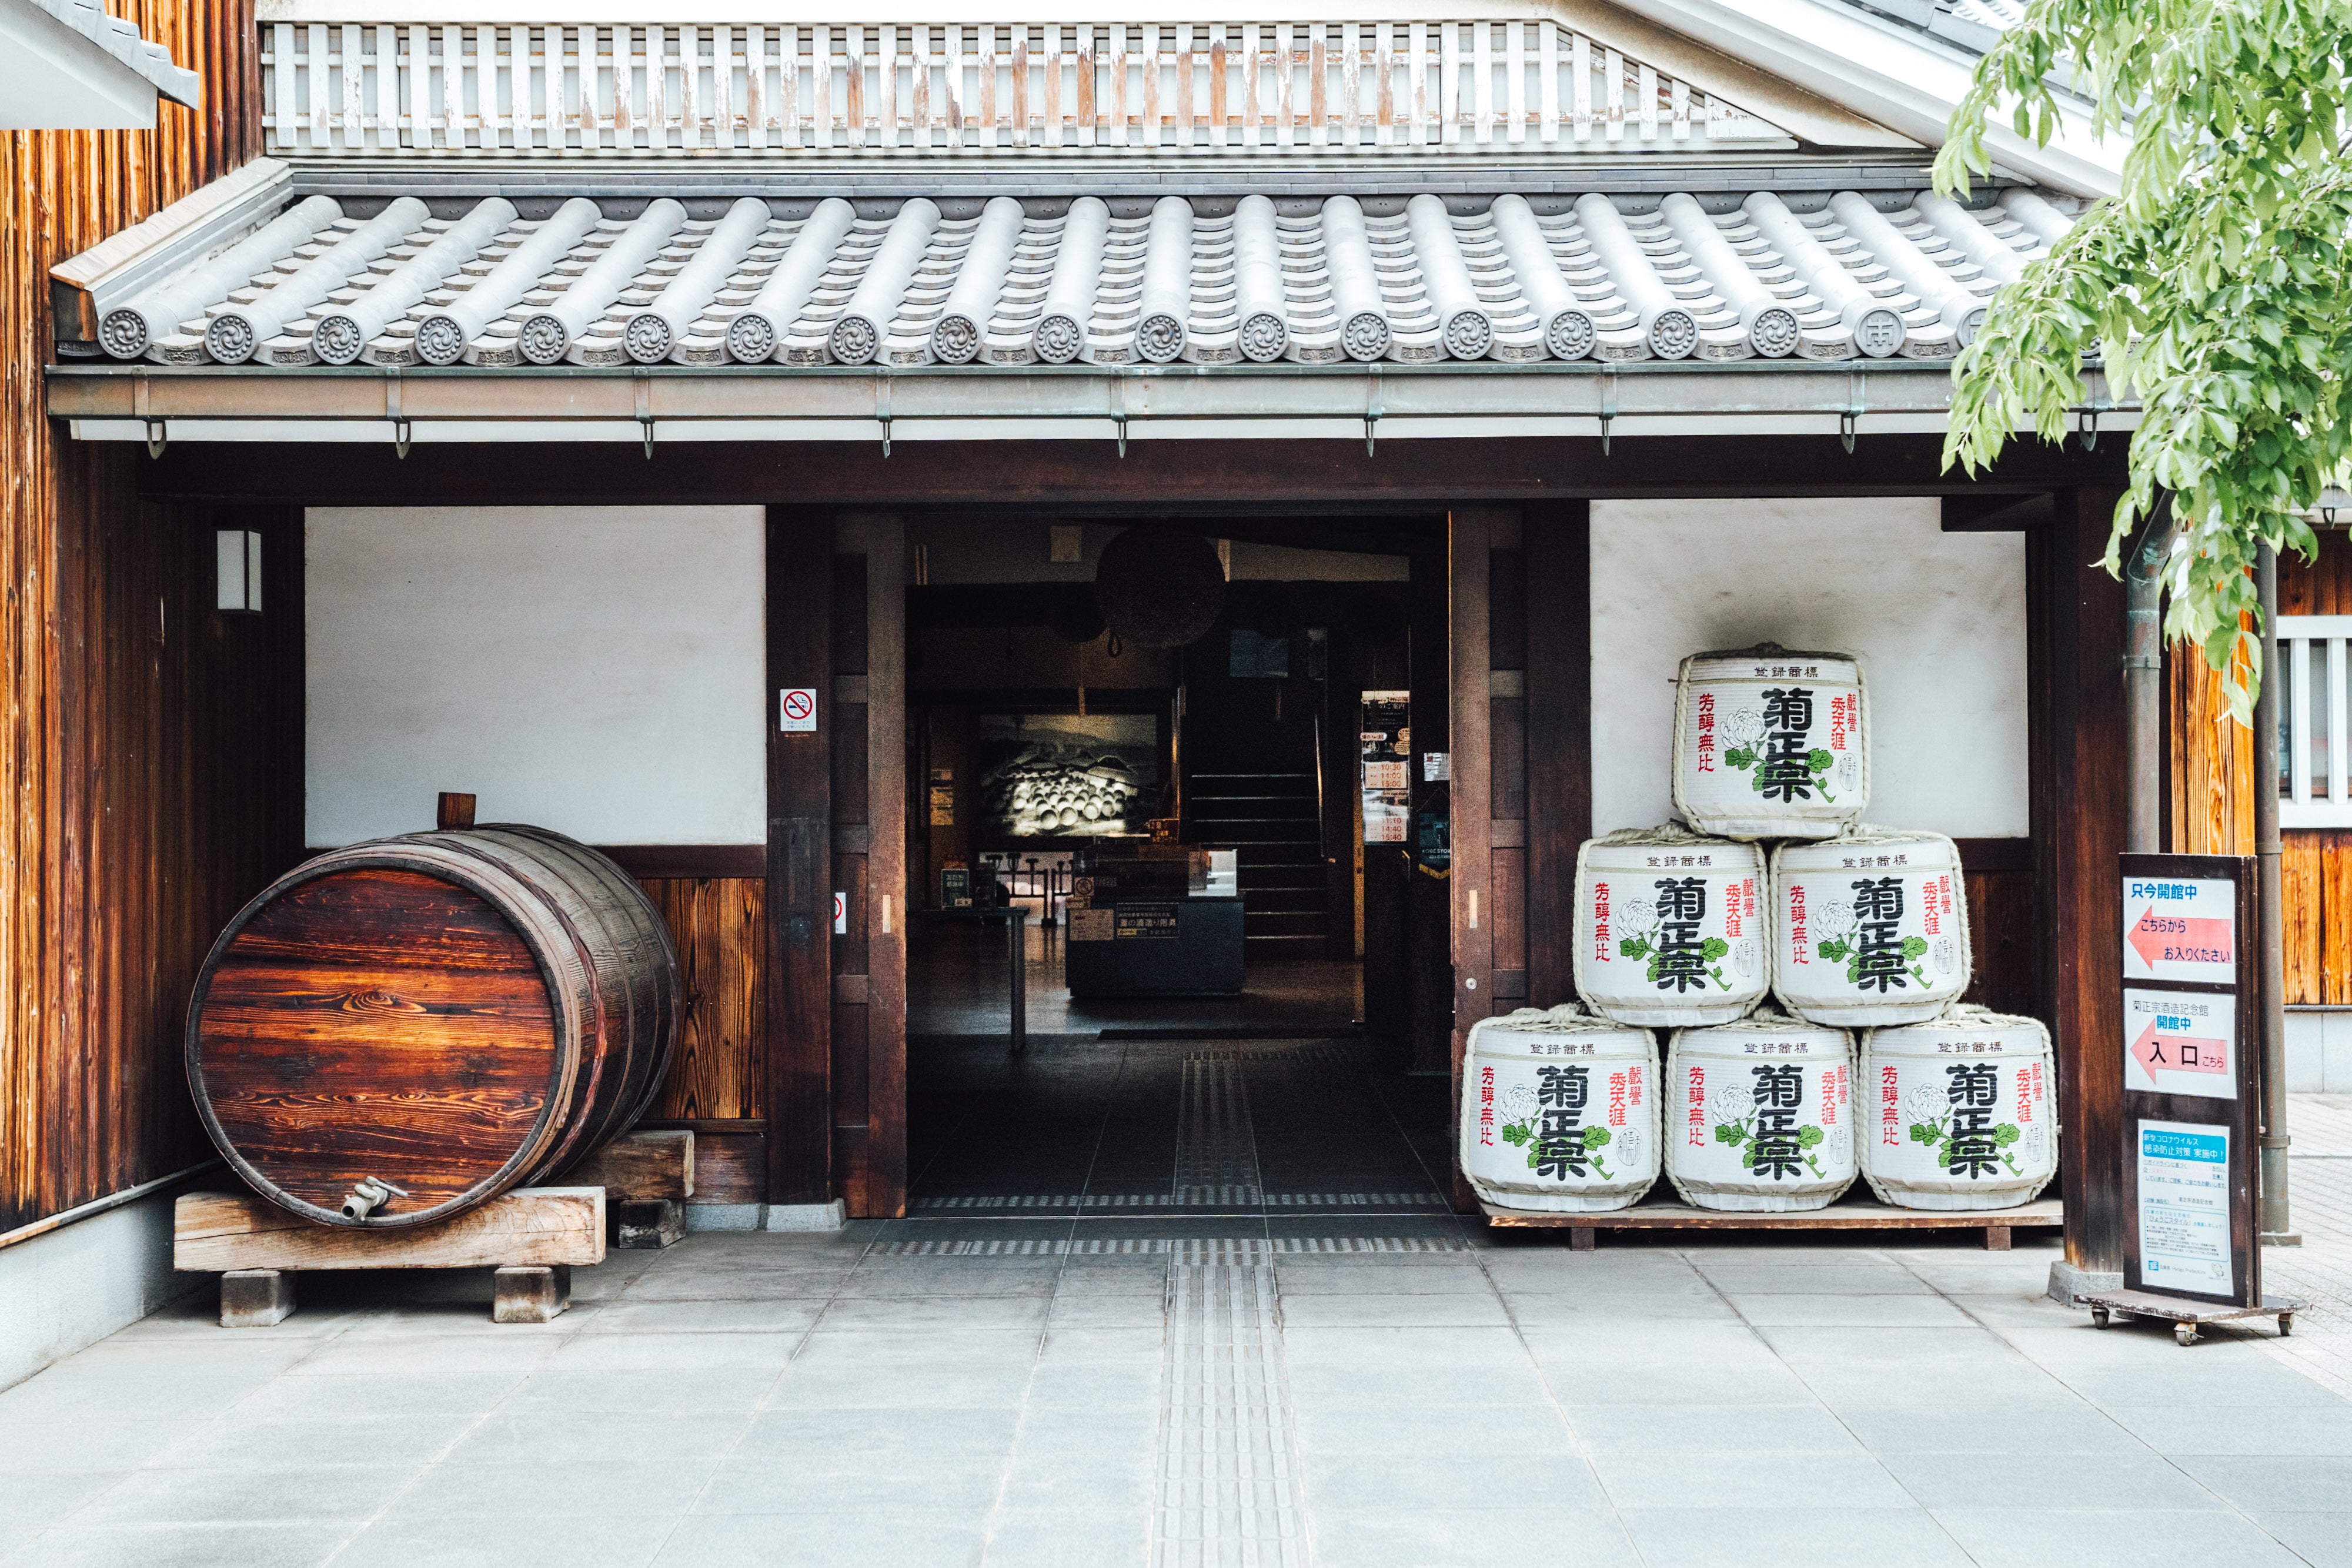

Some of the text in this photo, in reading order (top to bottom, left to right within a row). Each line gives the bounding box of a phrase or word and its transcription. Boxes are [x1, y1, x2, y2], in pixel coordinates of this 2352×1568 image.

[1698, 694, 1715, 772] 芳醇無比
[1762, 688, 1813, 803] 菊正宗
[1595, 882, 1610, 962] 芳醇無比
[1790, 885, 1809, 964] 芳醇無比
[2131, 883, 2197, 900] 只今開館中
[2141, 919, 2186, 932] こちらから
[1654, 877, 1707, 993] 菊正宗
[1851, 877, 1908, 994] 菊正宗
[2164, 947, 2230, 962] お入りください
[2132, 1001, 2209, 1017] 菊正宗酒造記念館
[2157, 1015, 2191, 1031] 開館中
[2203, 1057, 2224, 1068] こちら
[1481, 1067, 1494, 1146] 芳醇無比
[1536, 1065, 1589, 1181] 菊正宗
[1689, 1066, 1705, 1146] 芳醇無比
[1752, 1065, 1803, 1181] 菊正宗
[1882, 1066, 1899, 1146] 芳醇無比
[1946, 1063, 1999, 1179] 菊正宗
[2144, 1134, 2199, 1146] 新型コロナウイルス
[2144, 1144, 2191, 1157] 感染防止対策
